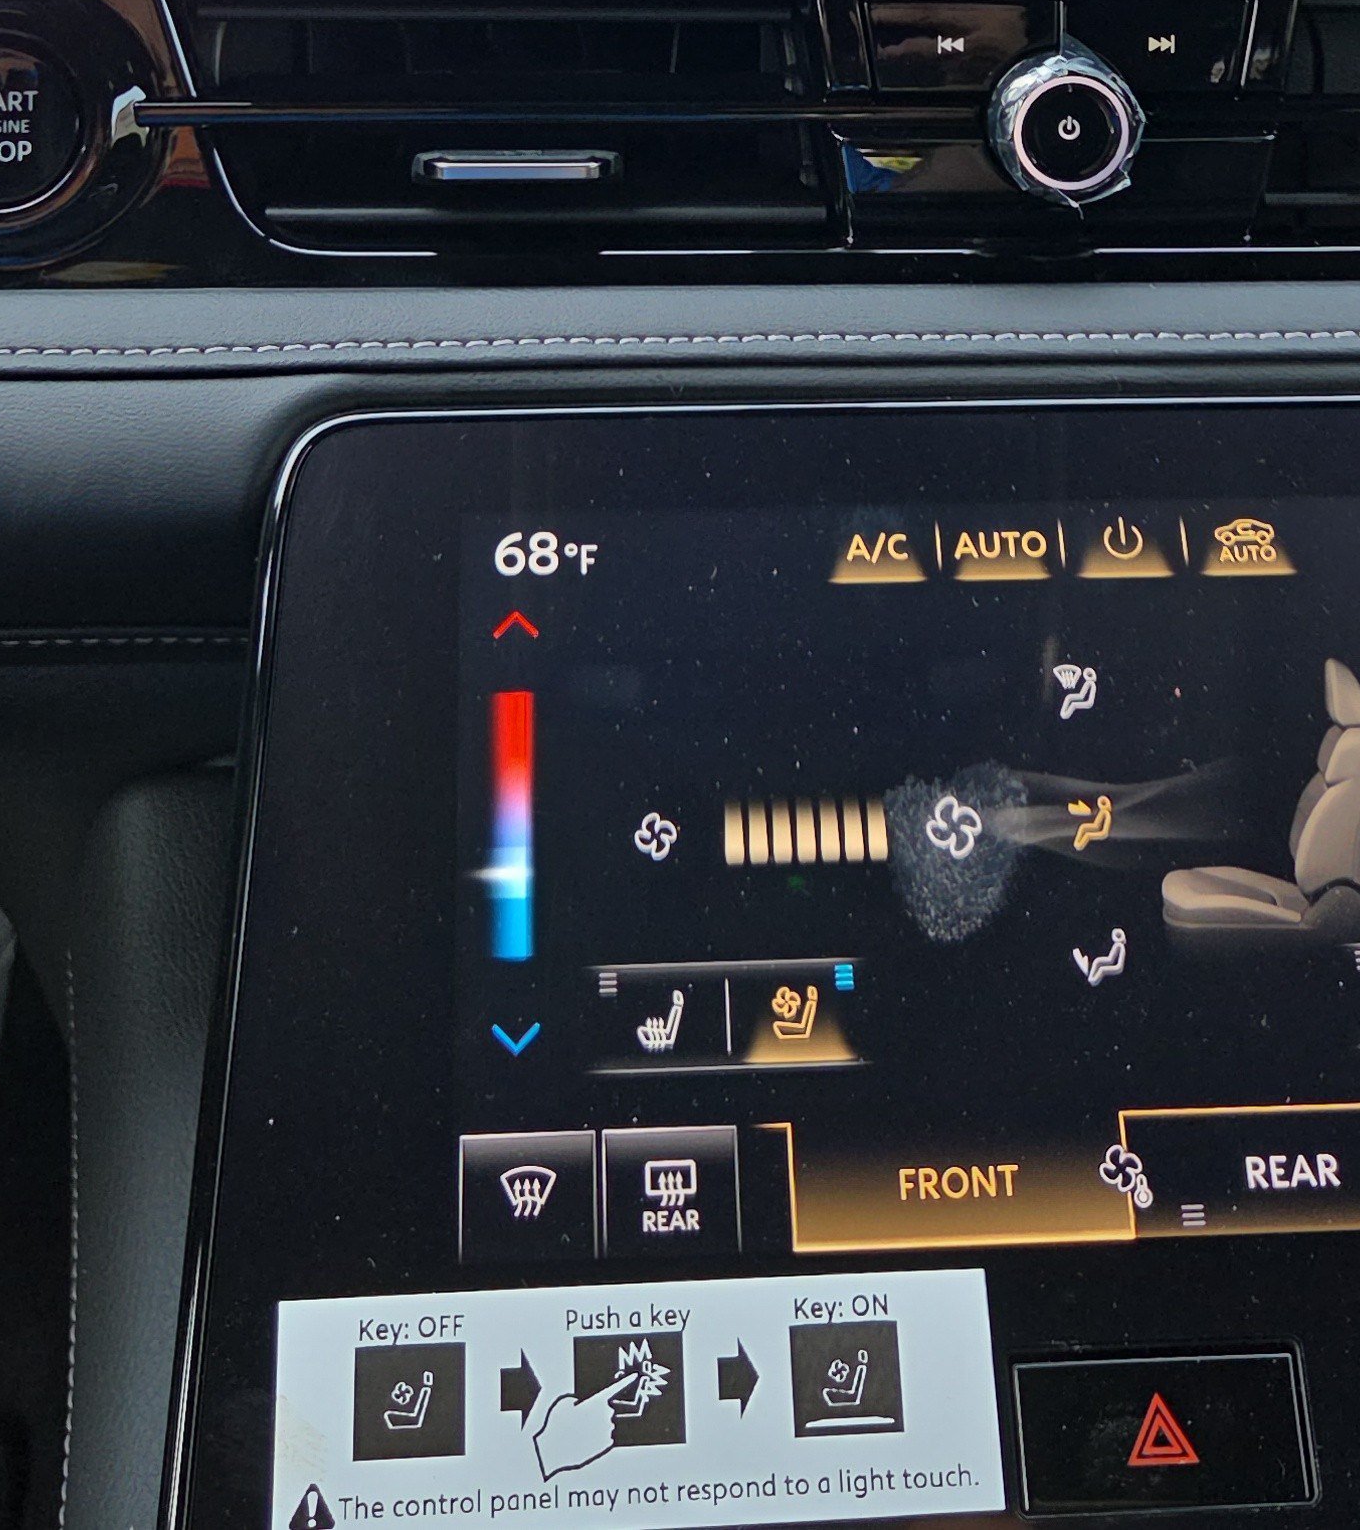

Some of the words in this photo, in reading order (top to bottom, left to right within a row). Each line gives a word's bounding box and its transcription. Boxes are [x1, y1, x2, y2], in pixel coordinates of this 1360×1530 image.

[846, 532, 909, 564] A/C
[954, 530, 1047, 561] AUTO
[1219, 545, 1277, 563] AUTO
[899, 1164, 1019, 1202] FRONT
[1245, 1153, 1341, 1190] REAR
[642, 1209, 700, 1233] REAR
[566, 1306, 619, 1331] Push
[629, 1311, 642, 1328] a
[650, 1303, 690, 1331] key
[794, 1298, 843, 1324] Key:
[852, 1294, 889, 1317] ON
[359, 1318, 409, 1345] Key:
[418, 1315, 465, 1338] OFF
[338, 1495, 385, 1520] The
[393, 1488, 481, 1518] control
[490, 1485, 559, 1518] panel
[568, 1488, 619, 1511] may
[628, 1481, 669, 1505] not
[677, 1473, 776, 1506] respond
[784, 1475, 810, 1496] to
[818, 1477, 831, 1494] a
[839, 1467, 896, 1499] light
[903, 1463, 980, 1489] touch.
